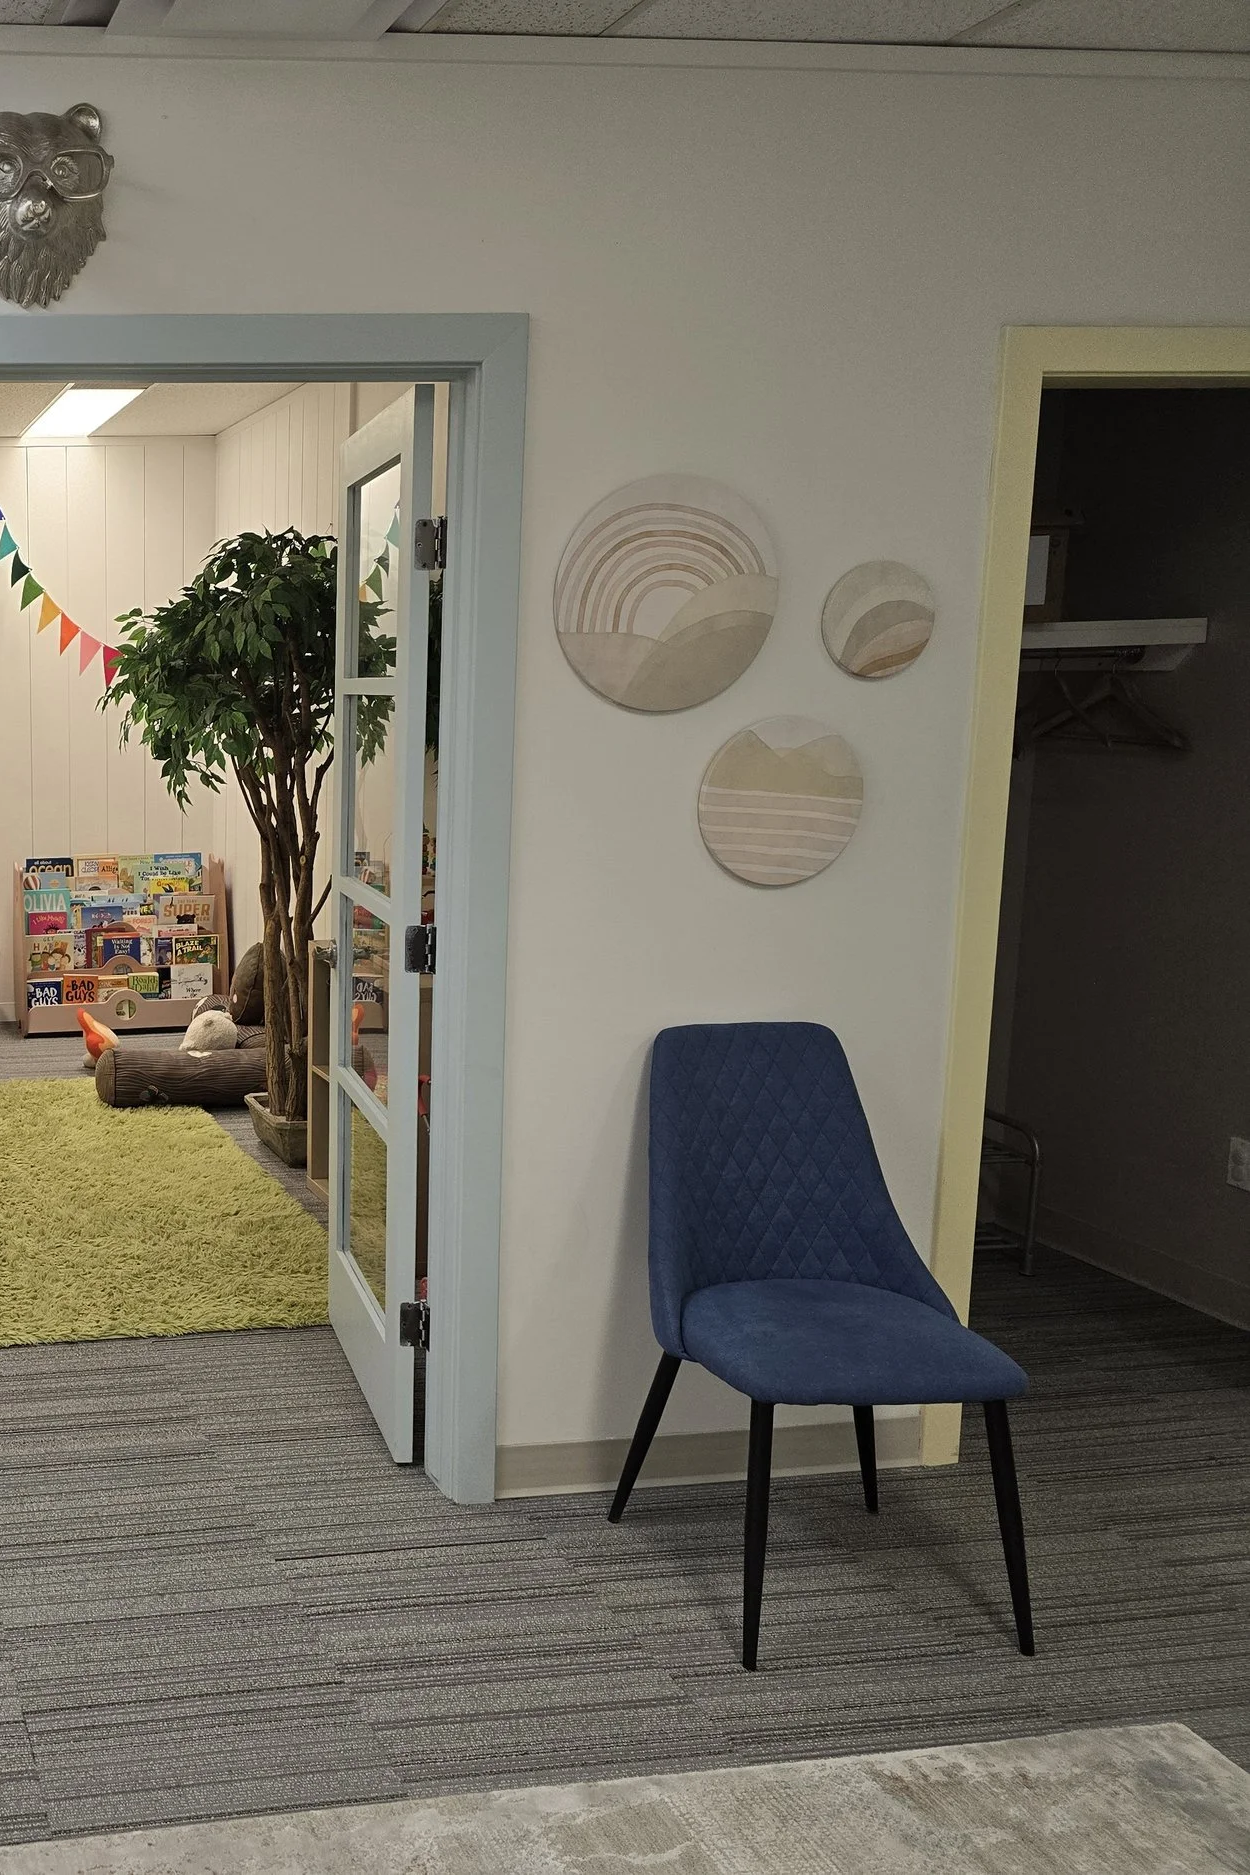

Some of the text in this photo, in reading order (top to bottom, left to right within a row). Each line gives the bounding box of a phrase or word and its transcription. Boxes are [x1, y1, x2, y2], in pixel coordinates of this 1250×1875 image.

[29, 864, 72, 877] ocean
[24, 893, 67, 912] OLIVIA
[163, 903, 211, 917] SUPER
[176, 940, 199, 950] BLAZE
[176, 945, 203, 957] A TRAIL
[71, 979, 95, 991] BAD
[35, 986, 58, 998] BAD
[65, 989, 96, 1003] GUYS
[31, 996, 58, 1006] GUYS
